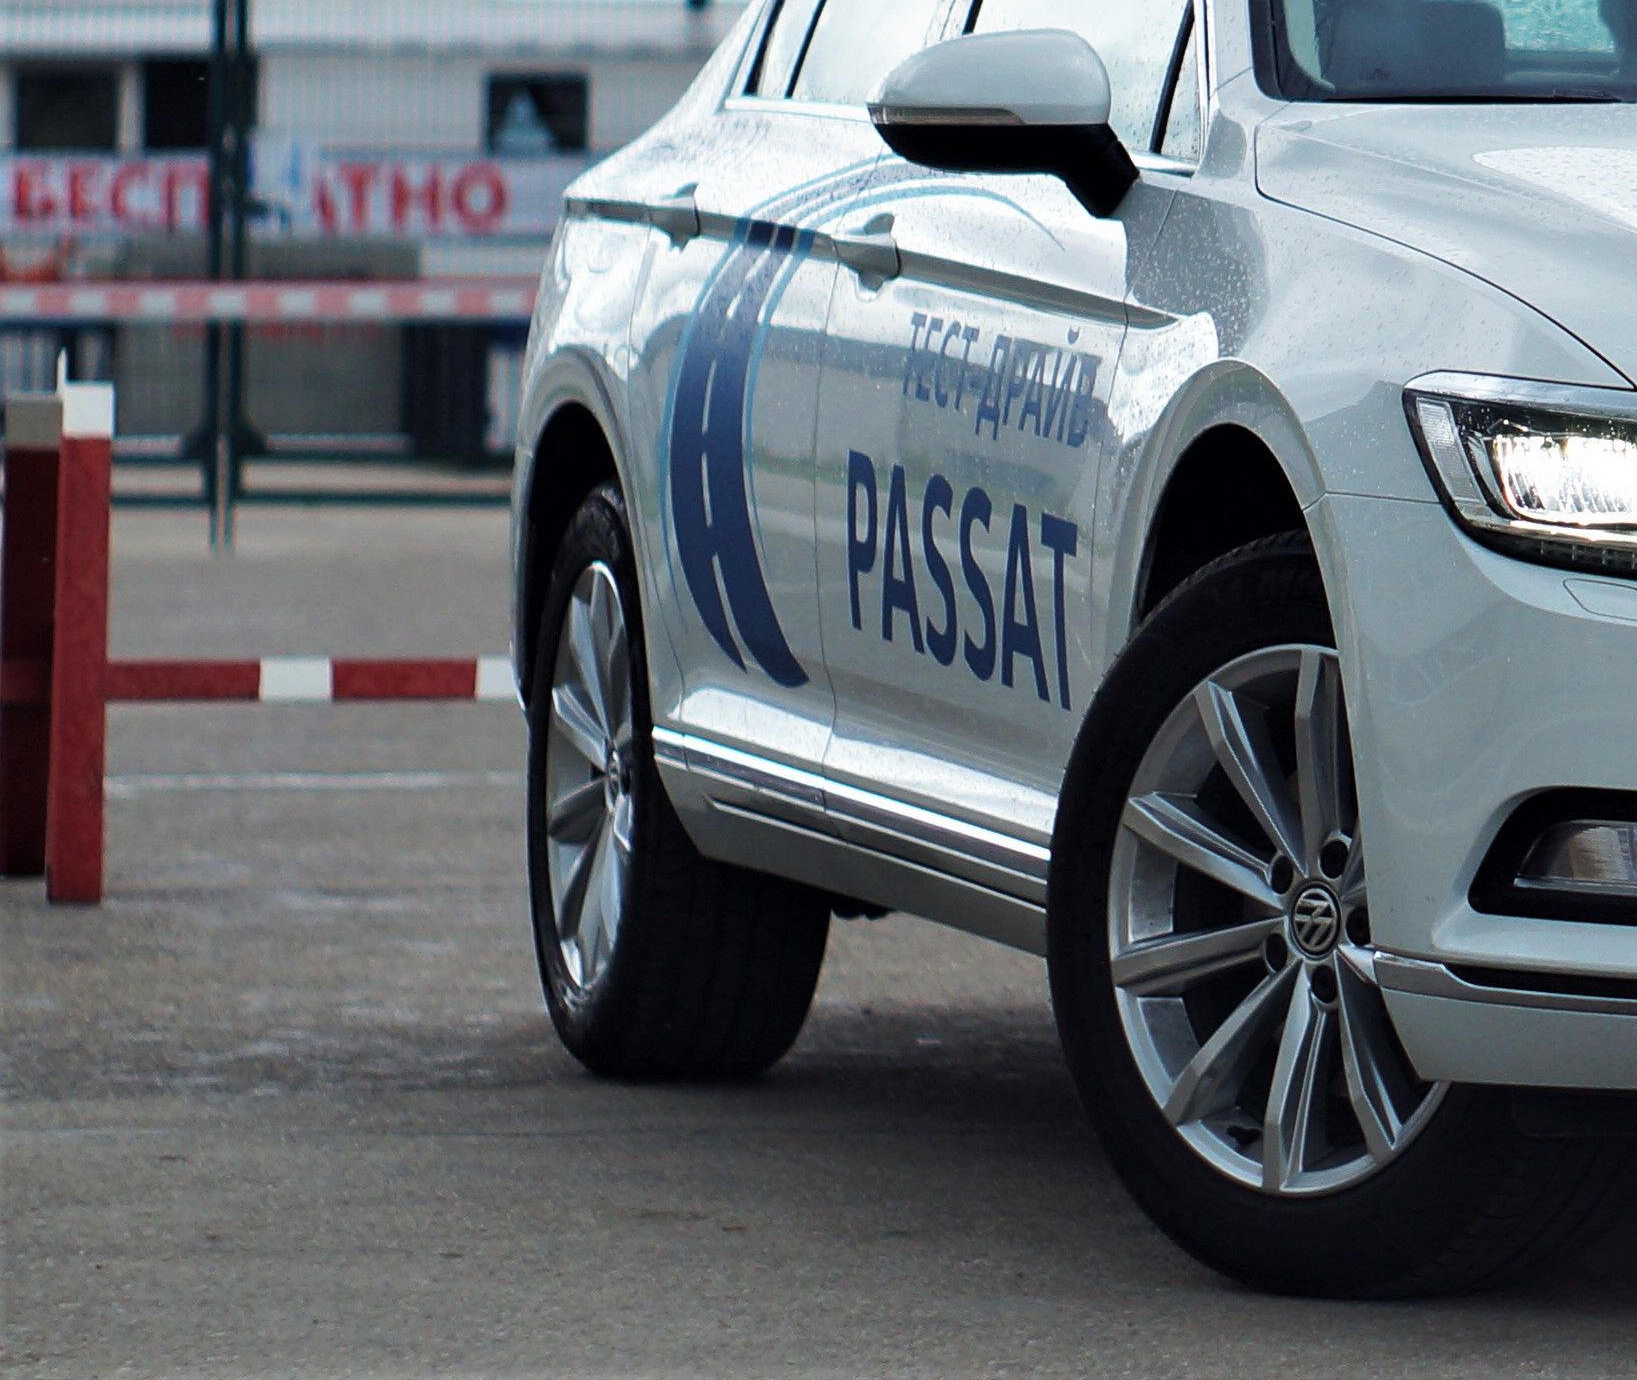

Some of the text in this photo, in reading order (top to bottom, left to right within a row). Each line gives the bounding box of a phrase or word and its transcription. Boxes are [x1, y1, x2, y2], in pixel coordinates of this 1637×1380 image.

[13, 161, 510, 233] БЕСПТНО
[902, 311, 1103, 448] ТЕСТ-ДРАЙВ
[846, 448, 1079, 713] PASSAT
